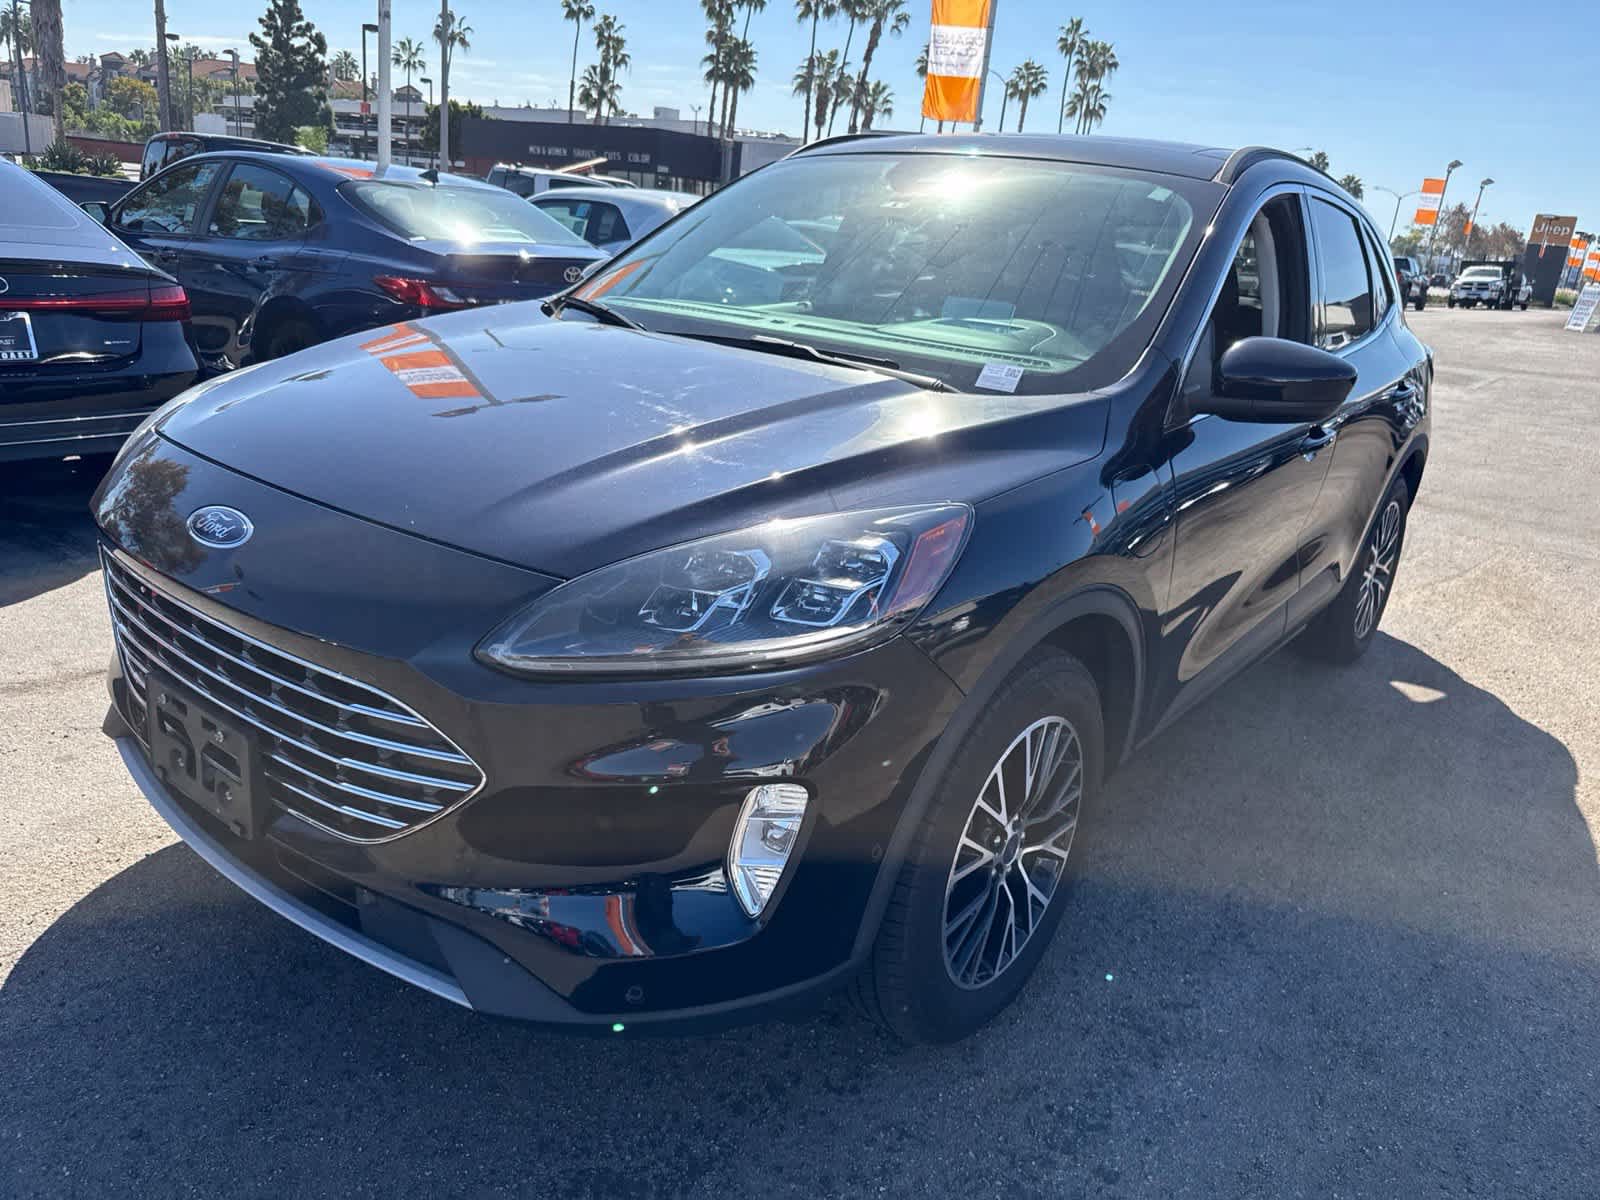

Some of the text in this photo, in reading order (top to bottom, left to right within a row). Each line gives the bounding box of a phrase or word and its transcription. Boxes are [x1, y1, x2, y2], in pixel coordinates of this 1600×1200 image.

[628, 153, 651, 163] COLOR
[1535, 223, 1570, 236] Jeep
[196, 511, 236, 538] Ford
